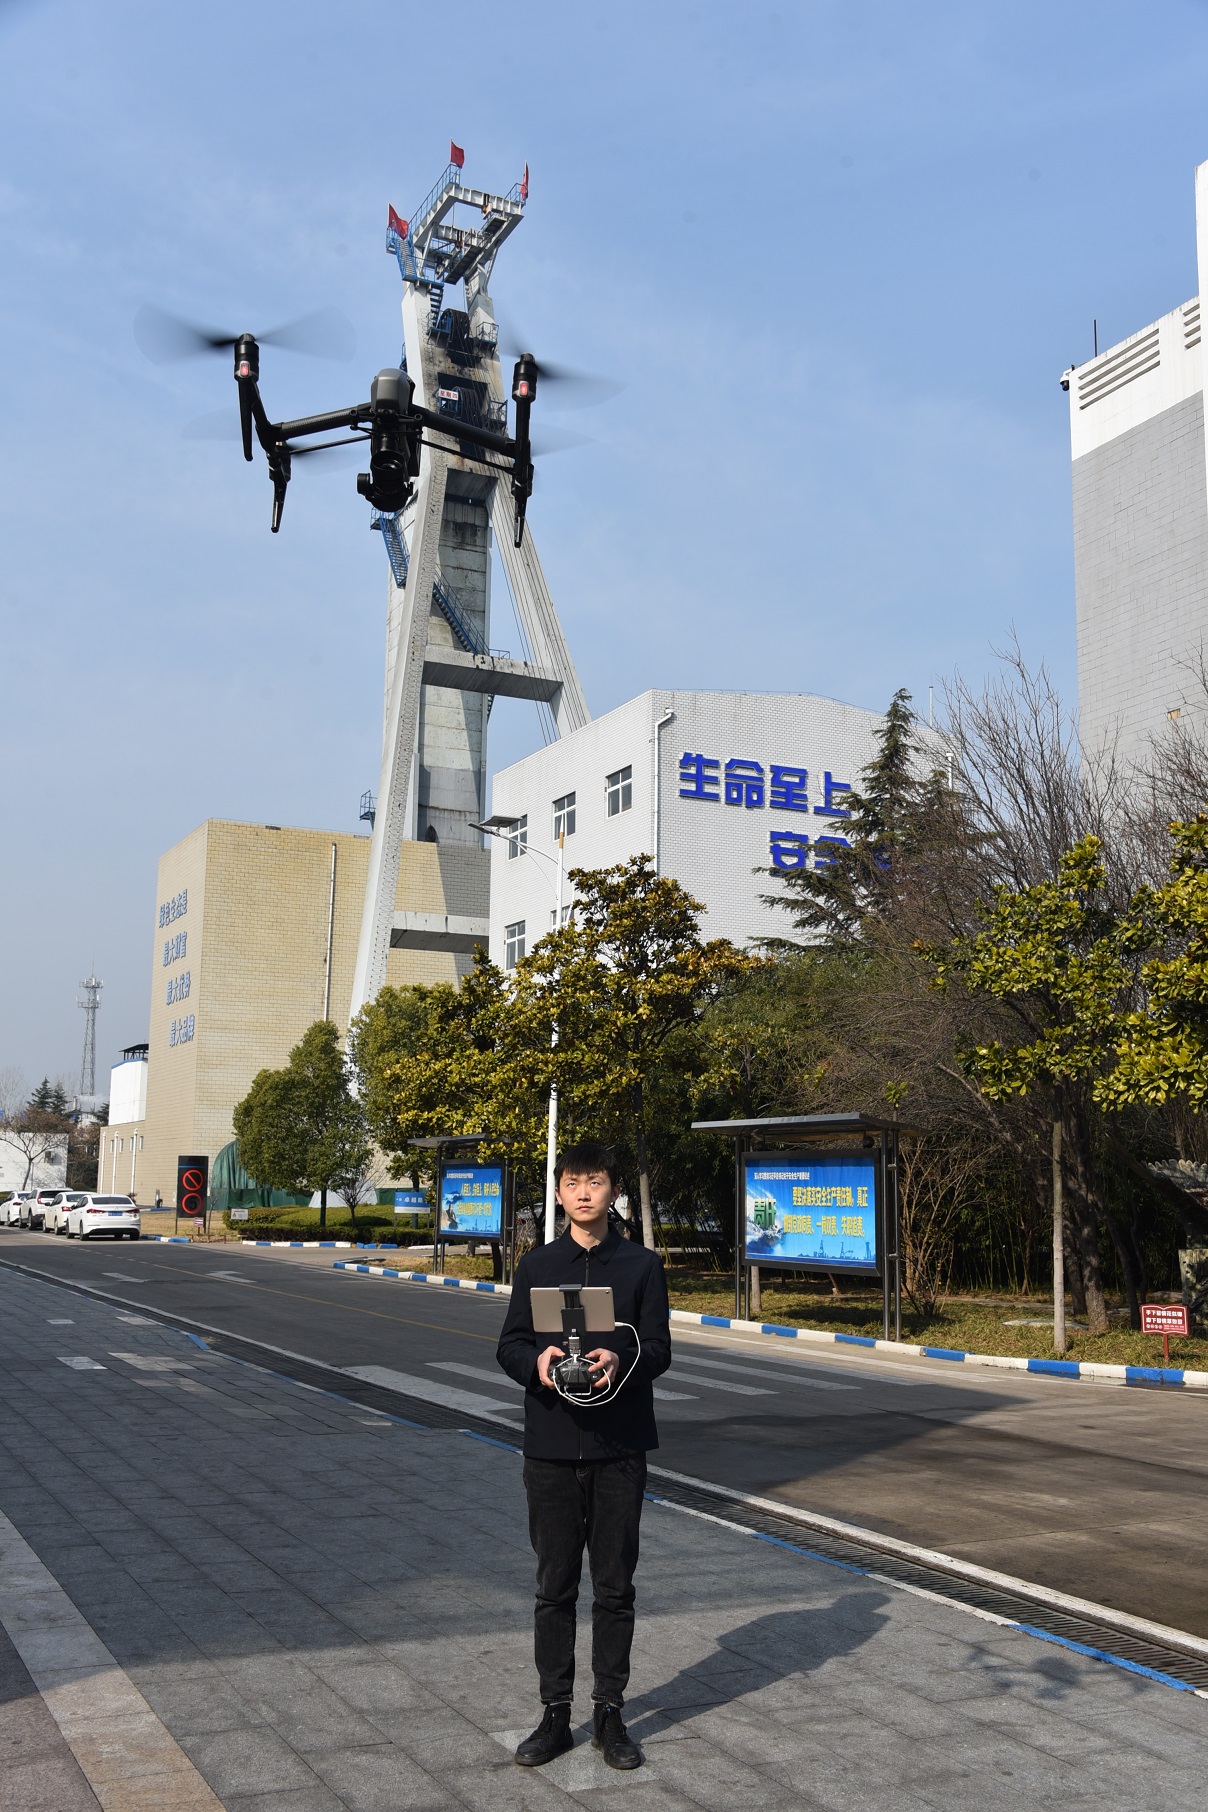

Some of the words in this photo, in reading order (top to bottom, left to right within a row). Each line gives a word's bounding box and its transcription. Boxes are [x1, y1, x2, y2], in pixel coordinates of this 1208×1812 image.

[679, 752, 851, 818] 生命至上
[163, 931, 188, 967] 最大财富
